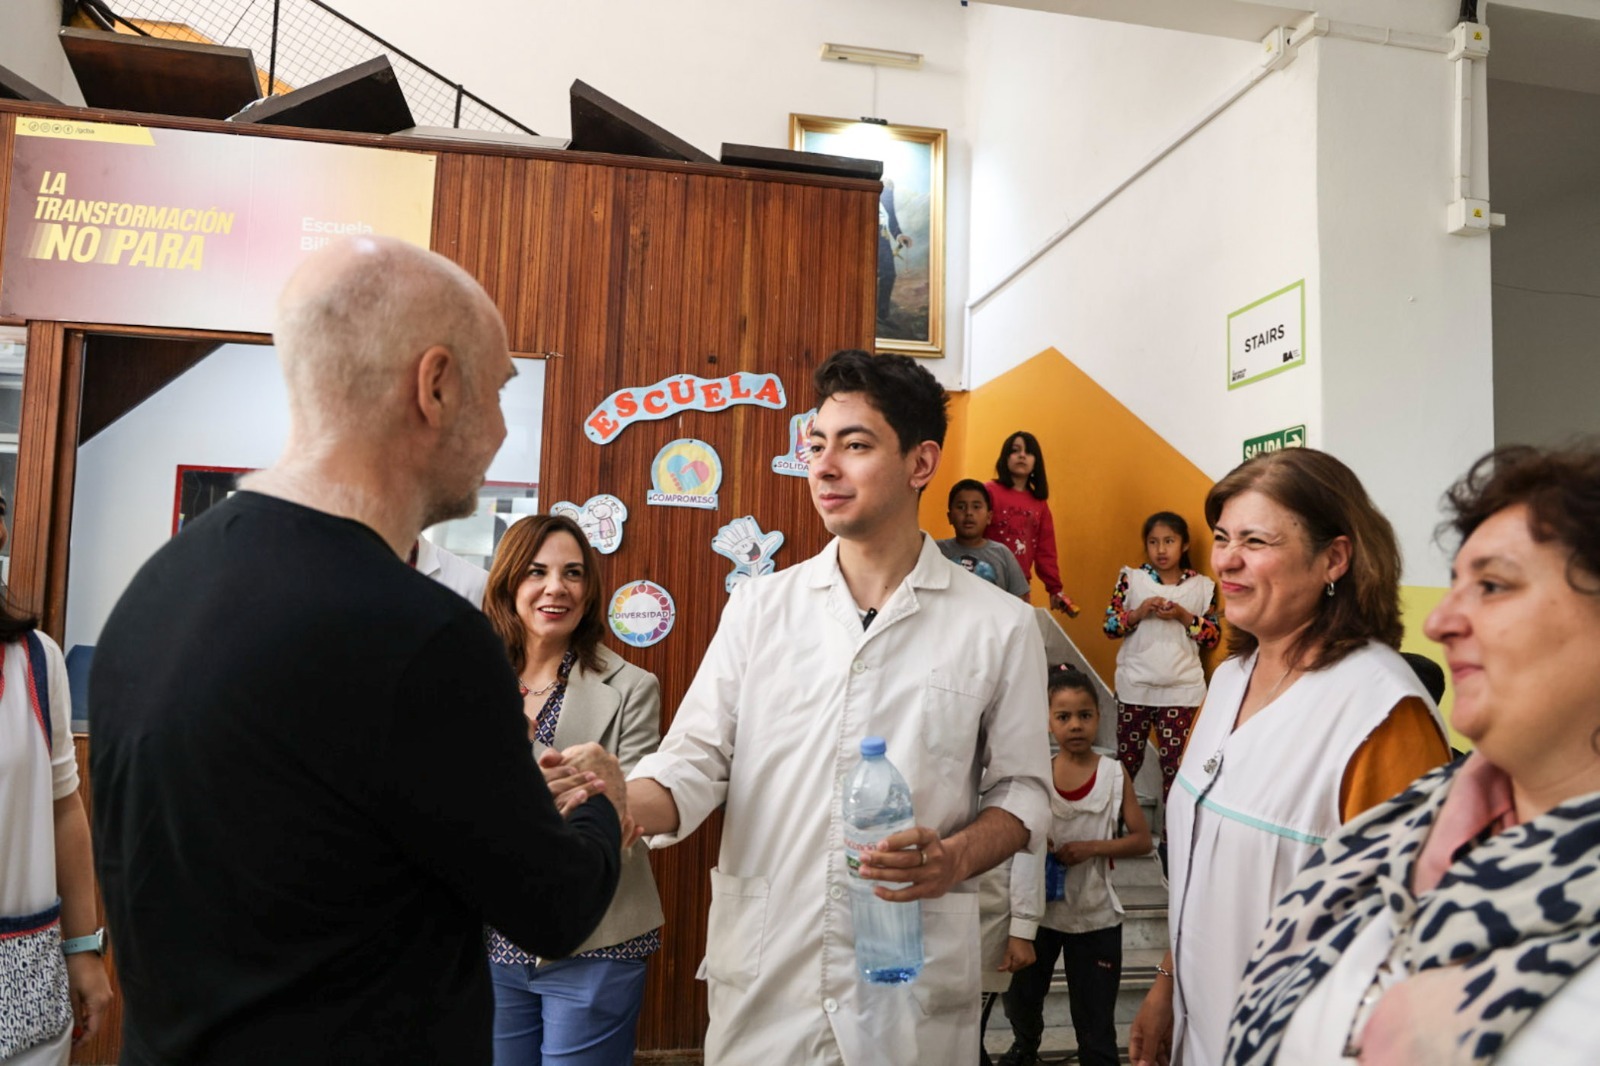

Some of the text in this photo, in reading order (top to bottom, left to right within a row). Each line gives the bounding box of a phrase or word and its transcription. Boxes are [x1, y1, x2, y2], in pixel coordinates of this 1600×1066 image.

[39, 171, 67, 195] LA
[35, 196, 235, 235] TRANSFORMACIÓN
[302, 216, 373, 235] Escuela
[42, 223, 205, 271] NO PARA
[1244, 324, 1285, 353] STAIRS
[588, 374, 781, 440] ESCUELA
[652, 493, 715, 504] COMPROMISO
[615, 611, 669, 620] DIVERSIDAD
